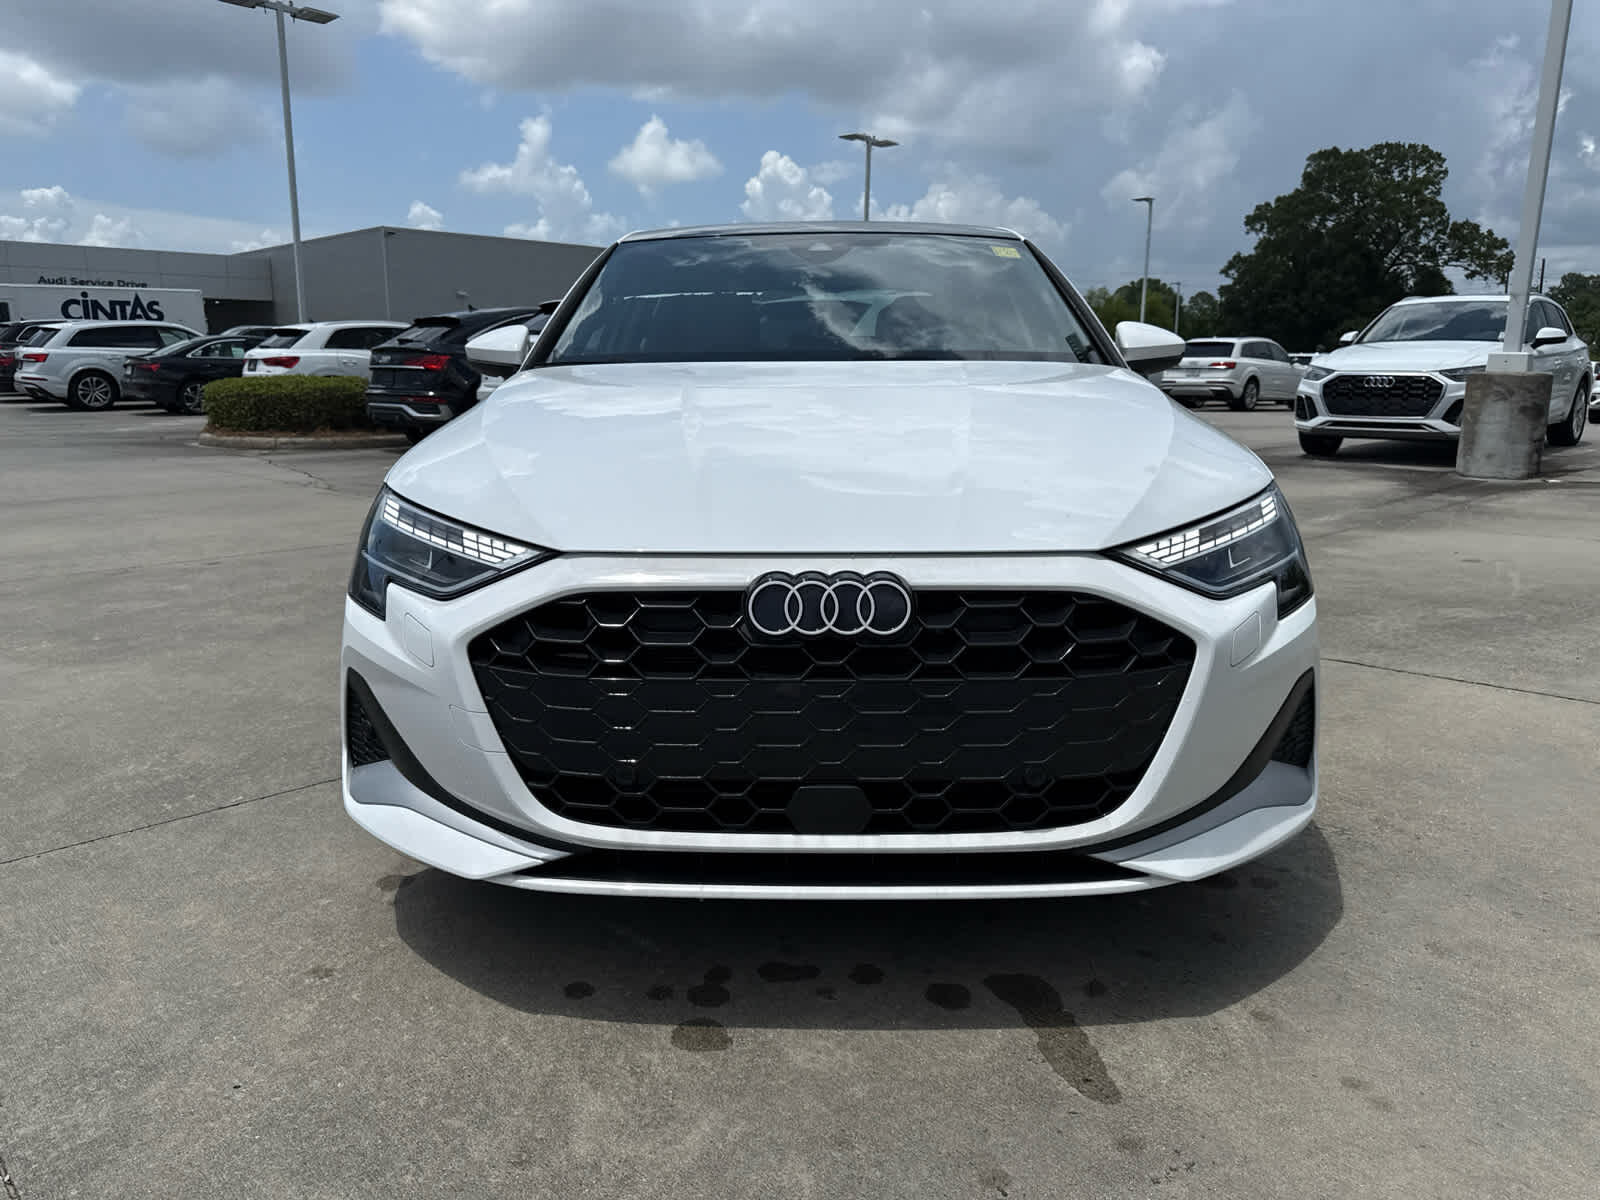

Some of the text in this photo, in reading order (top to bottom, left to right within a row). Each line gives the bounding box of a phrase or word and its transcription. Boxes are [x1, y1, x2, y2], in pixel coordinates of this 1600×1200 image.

[38, 276, 147, 288] Audi Service Drive
